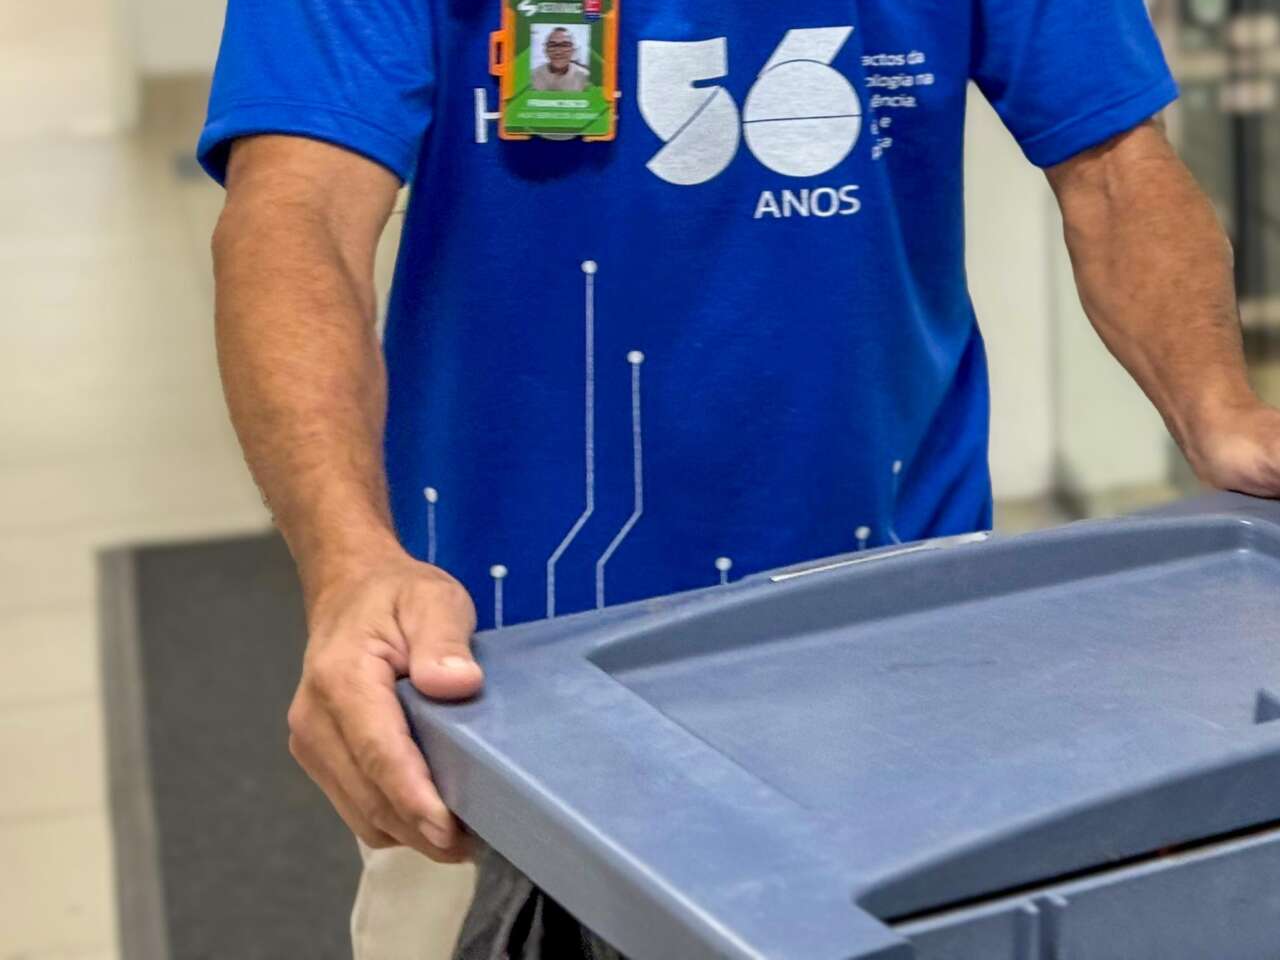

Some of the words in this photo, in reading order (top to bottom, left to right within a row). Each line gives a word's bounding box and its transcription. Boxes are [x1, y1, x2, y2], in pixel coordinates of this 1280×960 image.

[906, 50, 926, 65] da
[915, 73, 935, 86] na
[637, 26, 862, 186] 56
[753, 185, 861, 219] ANOS
